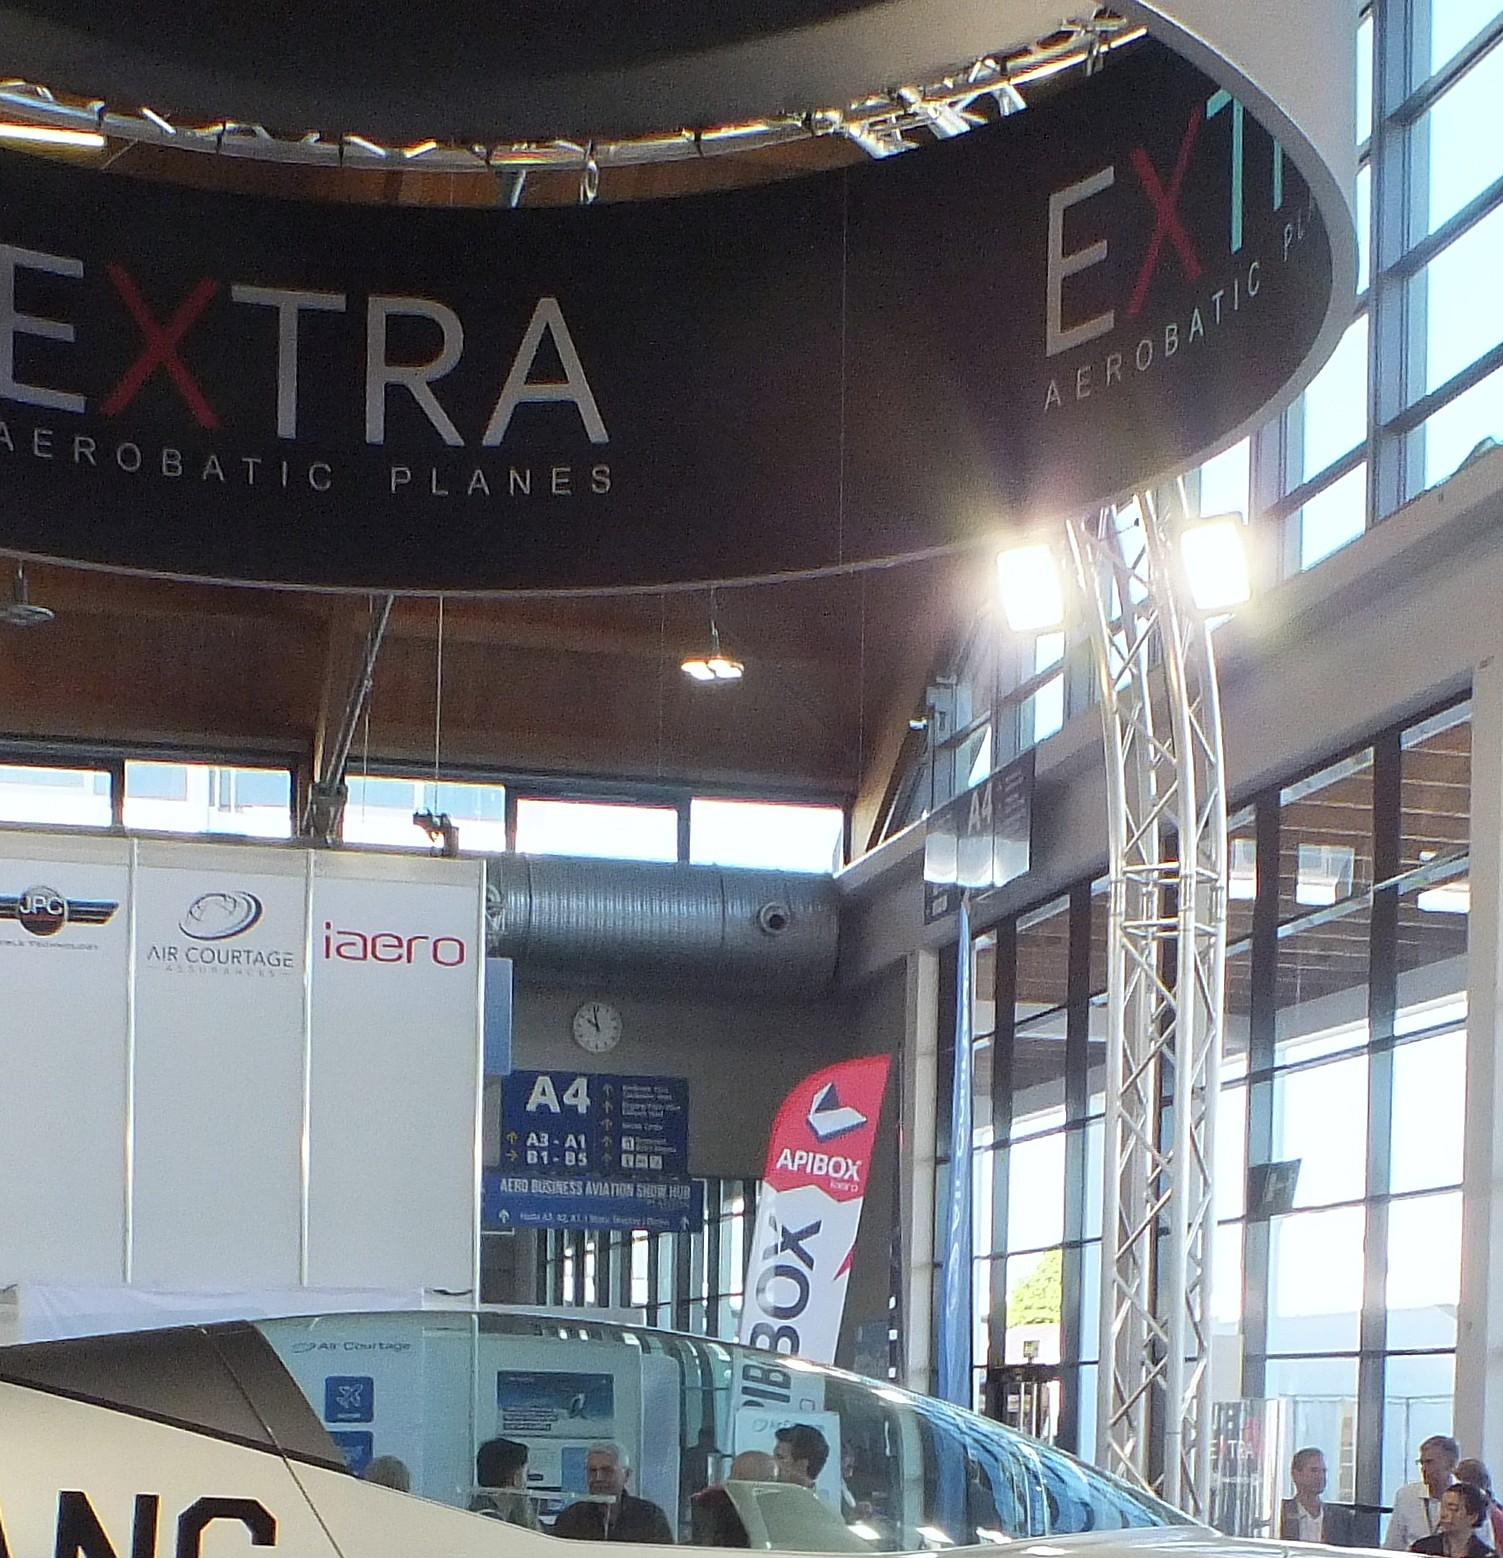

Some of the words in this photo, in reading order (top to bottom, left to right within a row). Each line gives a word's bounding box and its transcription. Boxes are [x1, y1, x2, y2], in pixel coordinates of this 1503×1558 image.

[1044, 262, 1261, 413] AEROBATIC
[390, 463, 613, 496] PLANES
[147, 945, 178, 962] AIR
[185, 946, 295, 969] COURTAGE
[324, 921, 466, 968] iaero
[525, 1075, 592, 1115] A4
[526, 1132, 549, 1147] A3
[564, 1134, 586, 1149] A1
[526, 1151, 549, 1165] B1
[776, 1147, 863, 1182] APIBOX
[500, 1178, 528, 1193] AERO
[531, 1179, 583, 1196] BUSINESS
[585, 1181, 634, 1198] AVIATION
[669, 1185, 691, 1199] HUB
